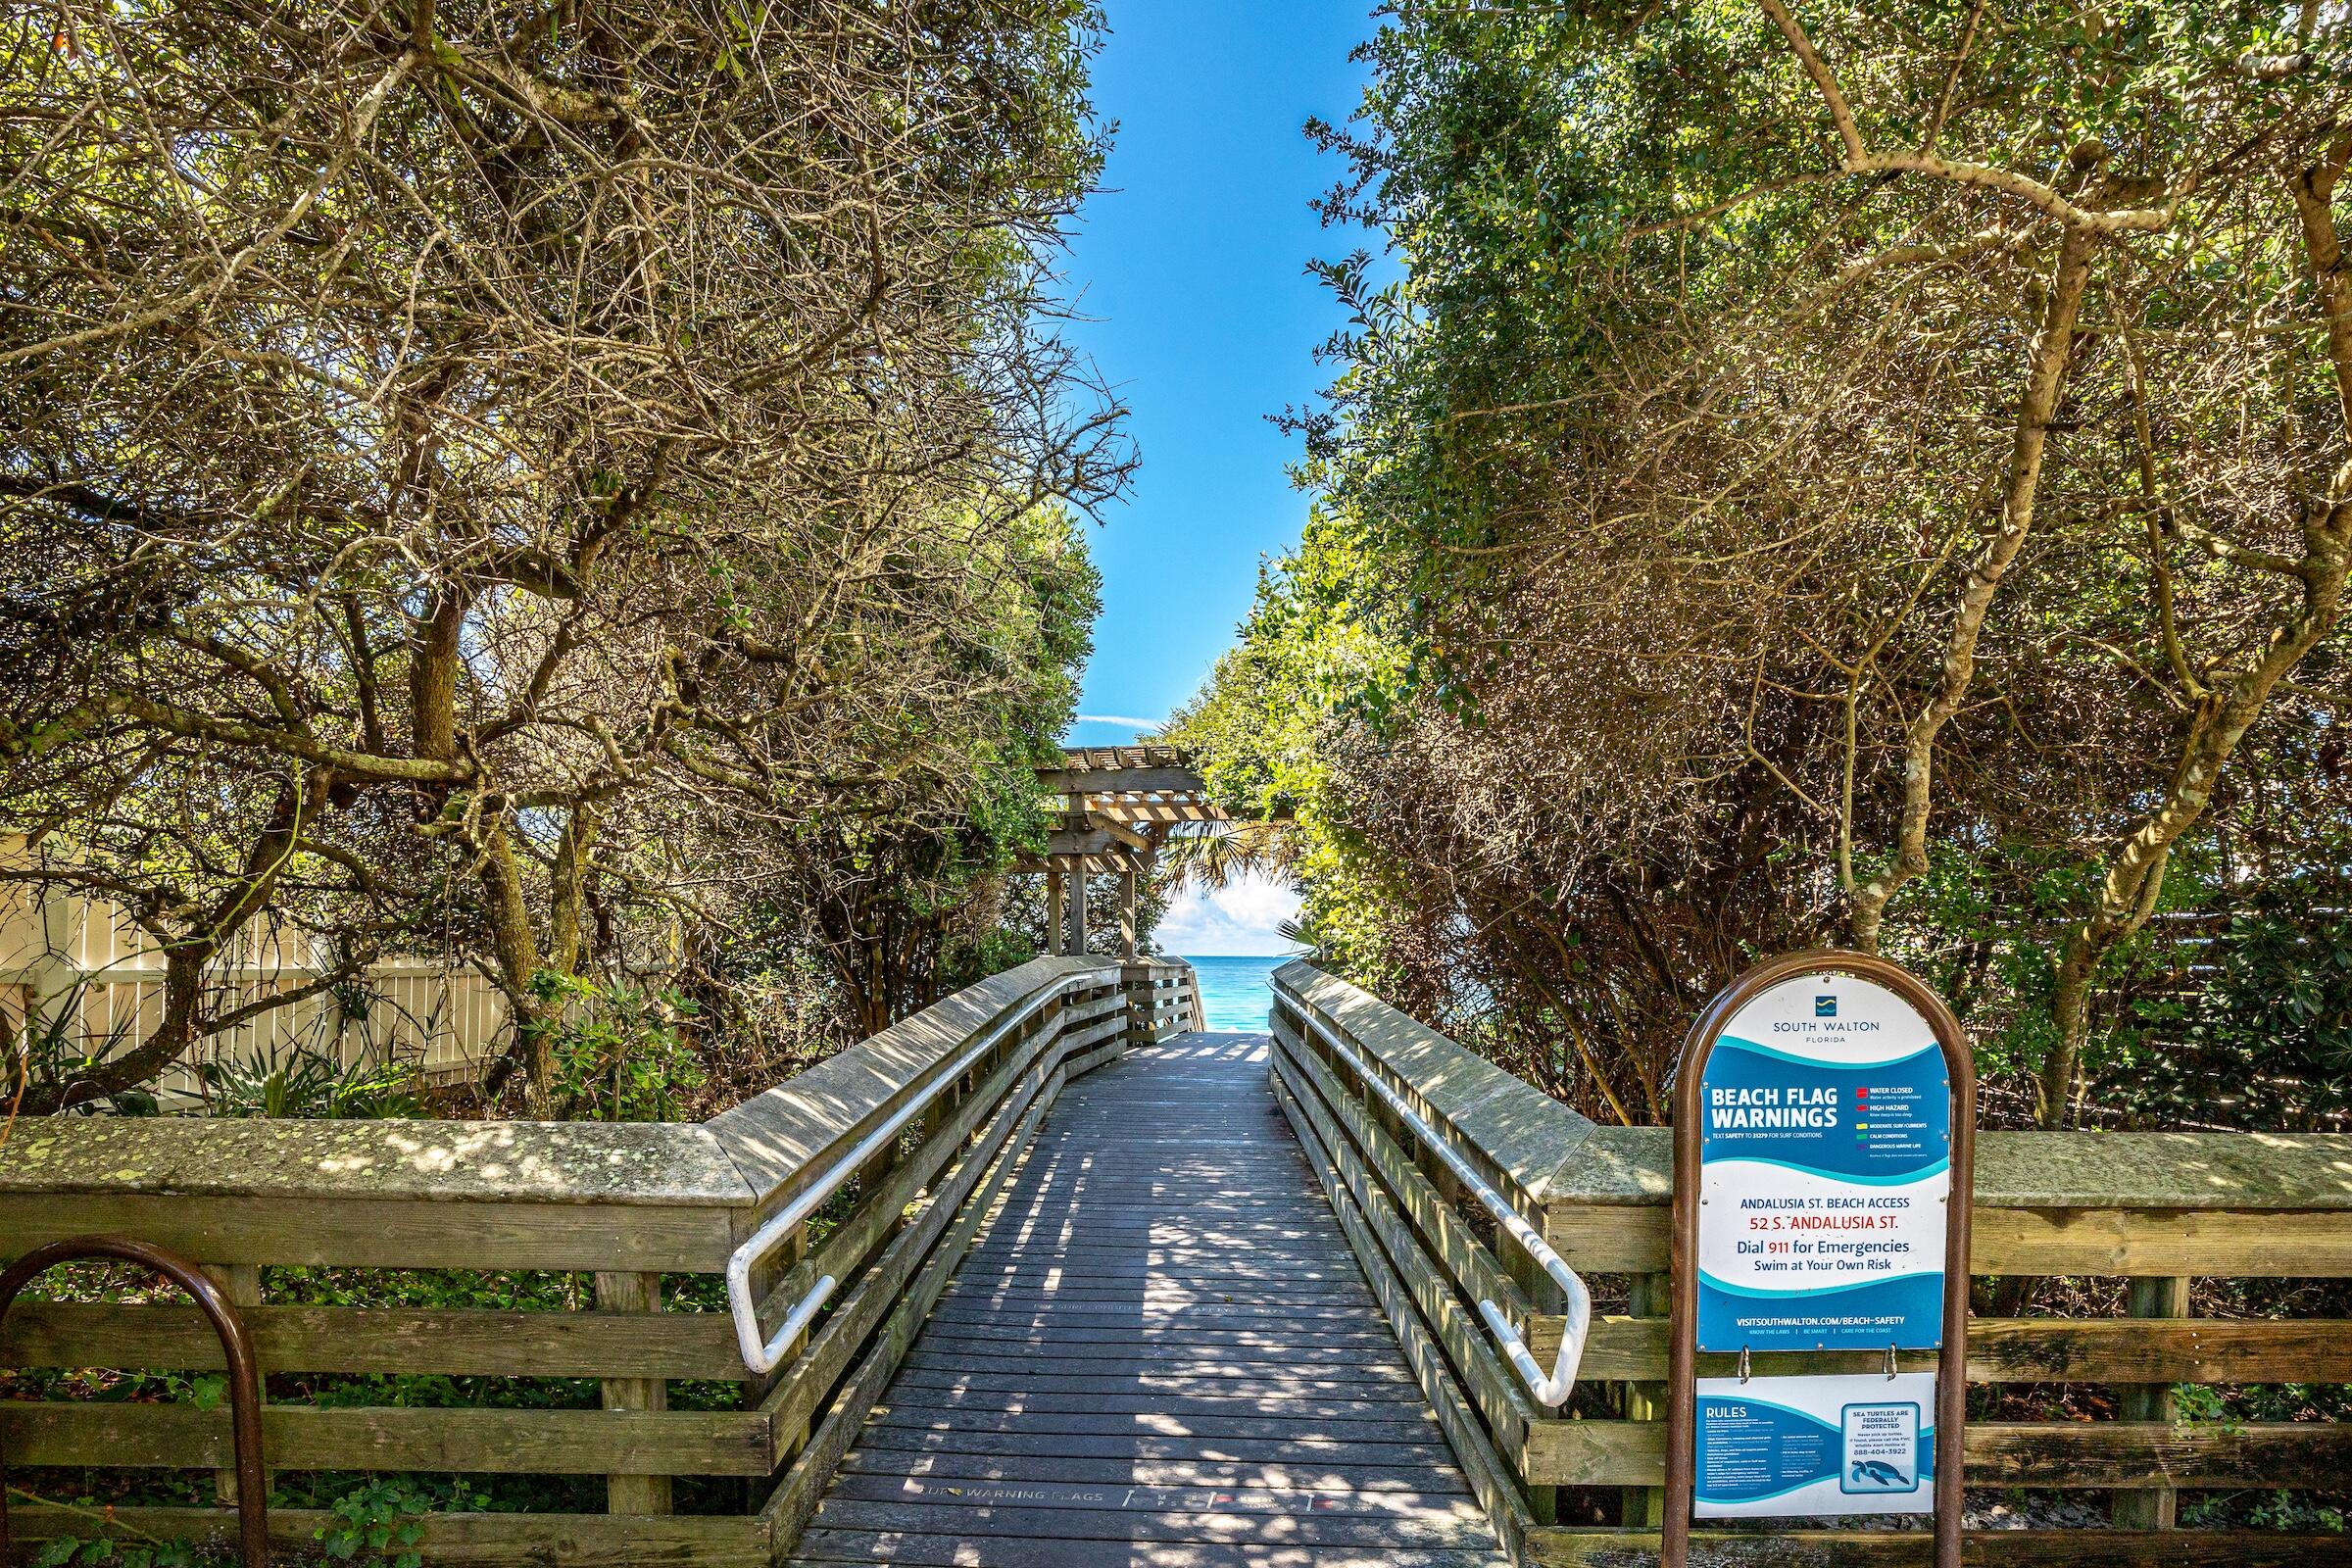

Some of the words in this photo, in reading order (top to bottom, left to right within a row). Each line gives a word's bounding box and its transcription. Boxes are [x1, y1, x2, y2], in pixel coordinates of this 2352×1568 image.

[1774, 1022, 1817, 1032] SOUTH
[1824, 1021, 1880, 1032] WALTON
[1711, 1088, 1779, 1105] BEACH
[1787, 1088, 1838, 1104] FLAG
[1711, 1107, 1838, 1128] WARNINGS
[1740, 1199, 1805, 1209] ANDALUSIA
[1808, 1199, 1824, 1208] ST.
[1827, 1199, 1864, 1208] BEACH
[1868, 1198, 1910, 1207] ACCESS
[1749, 1217, 1768, 1230] 52
[1772, 1217, 1786, 1230] S.
[1790, 1216, 1875, 1230] ANDALUSIA
[1879, 1215, 1898, 1229] ST.
[1738, 1241, 1764, 1253] Dial
[1768, 1242, 1789, 1253] 911
[1792, 1240, 1814, 1253] for
[1818, 1239, 1910, 1256] Emergencies
[1754, 1260, 1788, 1271] Swim
[1790, 1260, 1803, 1270] at
[1806, 1260, 1834, 1270] Your
[1837, 1260, 1864, 1270] Own
[1867, 1258, 1891, 1270] Risk
[1737, 1316, 1905, 1326] VISITSOUTHWALTON.COM/BEACH-SAFETY
[1706, 1407, 1747, 1418] RULES
[966, 1488, 1045, 1500] WARNING
[1051, 1491, 1103, 1501] FLAGS
